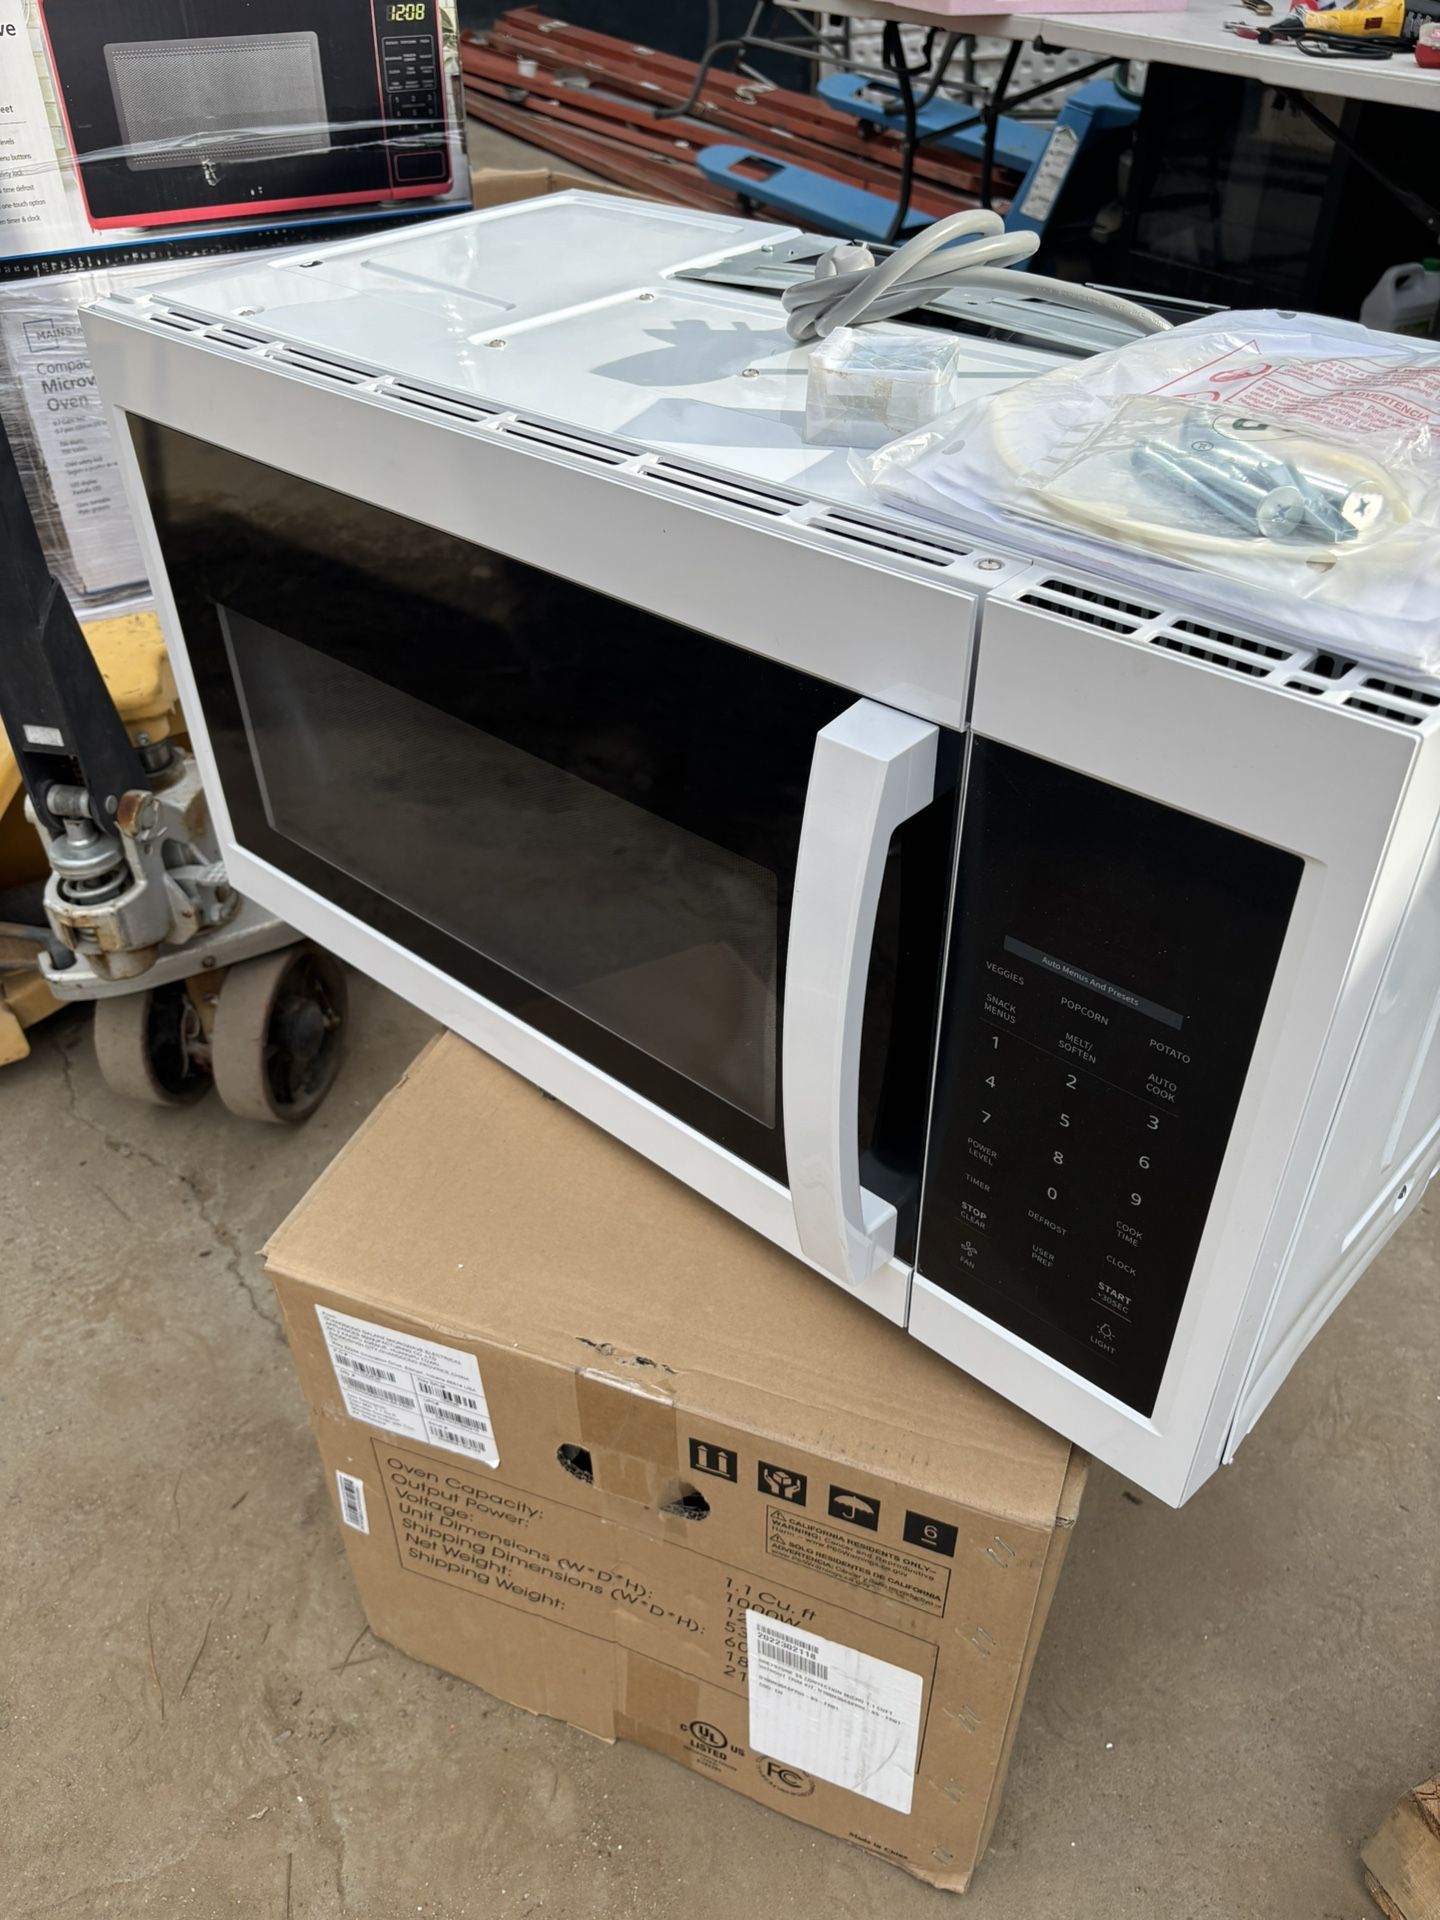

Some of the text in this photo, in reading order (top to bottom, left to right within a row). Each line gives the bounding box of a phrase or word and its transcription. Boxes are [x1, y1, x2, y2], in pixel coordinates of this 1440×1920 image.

[16, 184, 35, 192] defrost
[47, 395, 89, 412] Oven
[986, 961, 1025, 985] VEGGIES
[1041, 956, 1140, 1006] Auto Menus And Presets
[984, 1003, 1016, 1024] MENUS
[986, 993, 1016, 1014] SNACK
[1060, 996, 1109, 1026] POPCORN
[992, 1036, 999, 1049] 1
[1058, 1040, 1096, 1064] SOFTEN
[1065, 1032, 1094, 1052] MELT/
[1149, 1039, 1191, 1064] POTATO
[985, 1075, 996, 1088] 4
[1066, 1074, 1077, 1090] 2
[1148, 1073, 1177, 1092] AUTO
[1146, 1083, 1175, 1103] COOK
[981, 1110, 991, 1123] 7
[1059, 1113, 1070, 1128] 5
[1146, 1115, 1159, 1130] 3
[967, 1137, 998, 1159] POWER
[968, 1147, 993, 1166] LEVEL
[1053, 1151, 1064, 1165] 8
[1139, 1155, 1150, 1169] 6
[965, 1173, 991, 1192] TIMER
[1047, 1187, 1058, 1200] 0
[1130, 1192, 1142, 1206] 9
[960, 1210, 986, 1229] CLEAR
[961, 1201, 987, 1219] STOP
[1027, 1209, 1067, 1236] DEFROST
[1116, 1220, 1143, 1239] COOK
[1116, 1229, 1139, 1247] TIME
[959, 1255, 975, 1269] FAN
[1031, 1252, 1053, 1268] PREF
[1032, 1244, 1055, 1261] USER
[1106, 1254, 1136, 1276] CLOCK
[1098, 1281, 1132, 1305] START
[1090, 1335, 1116, 1354] LIGHT
[387, 1457, 544, 1519] Oven Capacity:
[391, 1473, 459, 1503] Output
[466, 1497, 530, 1528] Power:
[395, 1486, 473, 1522] Voltage:
[399, 1503, 434, 1521] Unit
[440, 1516, 550, 1562] Dimensions
[788, 1517, 845, 1542] CALIFORNIA
[846, 1537, 900, 1562] RESIDENTS
[923, 1524, 938, 1540] 6
[402, 1518, 486, 1555] Shipping
[492, 1546, 603, 1595] Dimensions
[405, 1532, 512, 1577] Net Weight:
[770, 1541, 833, 1569] ADVERTENCIA:
[771, 1518, 934, 1582] WARNING: Cancer and Reproductive
[408, 1547, 565, 1611] Shipping Weight:
[787, 1540, 813, 1555] SOLO
[815, 1550, 871, 1576] RESIDENTES
[872, 1570, 885, 1581] DE
[887, 1576, 942, 1601] CALIFORNIA
[726, 1577, 817, 1621] 1.1 Cu. ft
[756, 1630, 816, 1661] 2022302118
[723, 1665, 746, 1682] 21
[690, 1740, 727, 1761] LISTED
[699, 1725, 718, 1744] UL
[730, 1744, 745, 1757] US
[849, 1832, 871, 1844] Made
